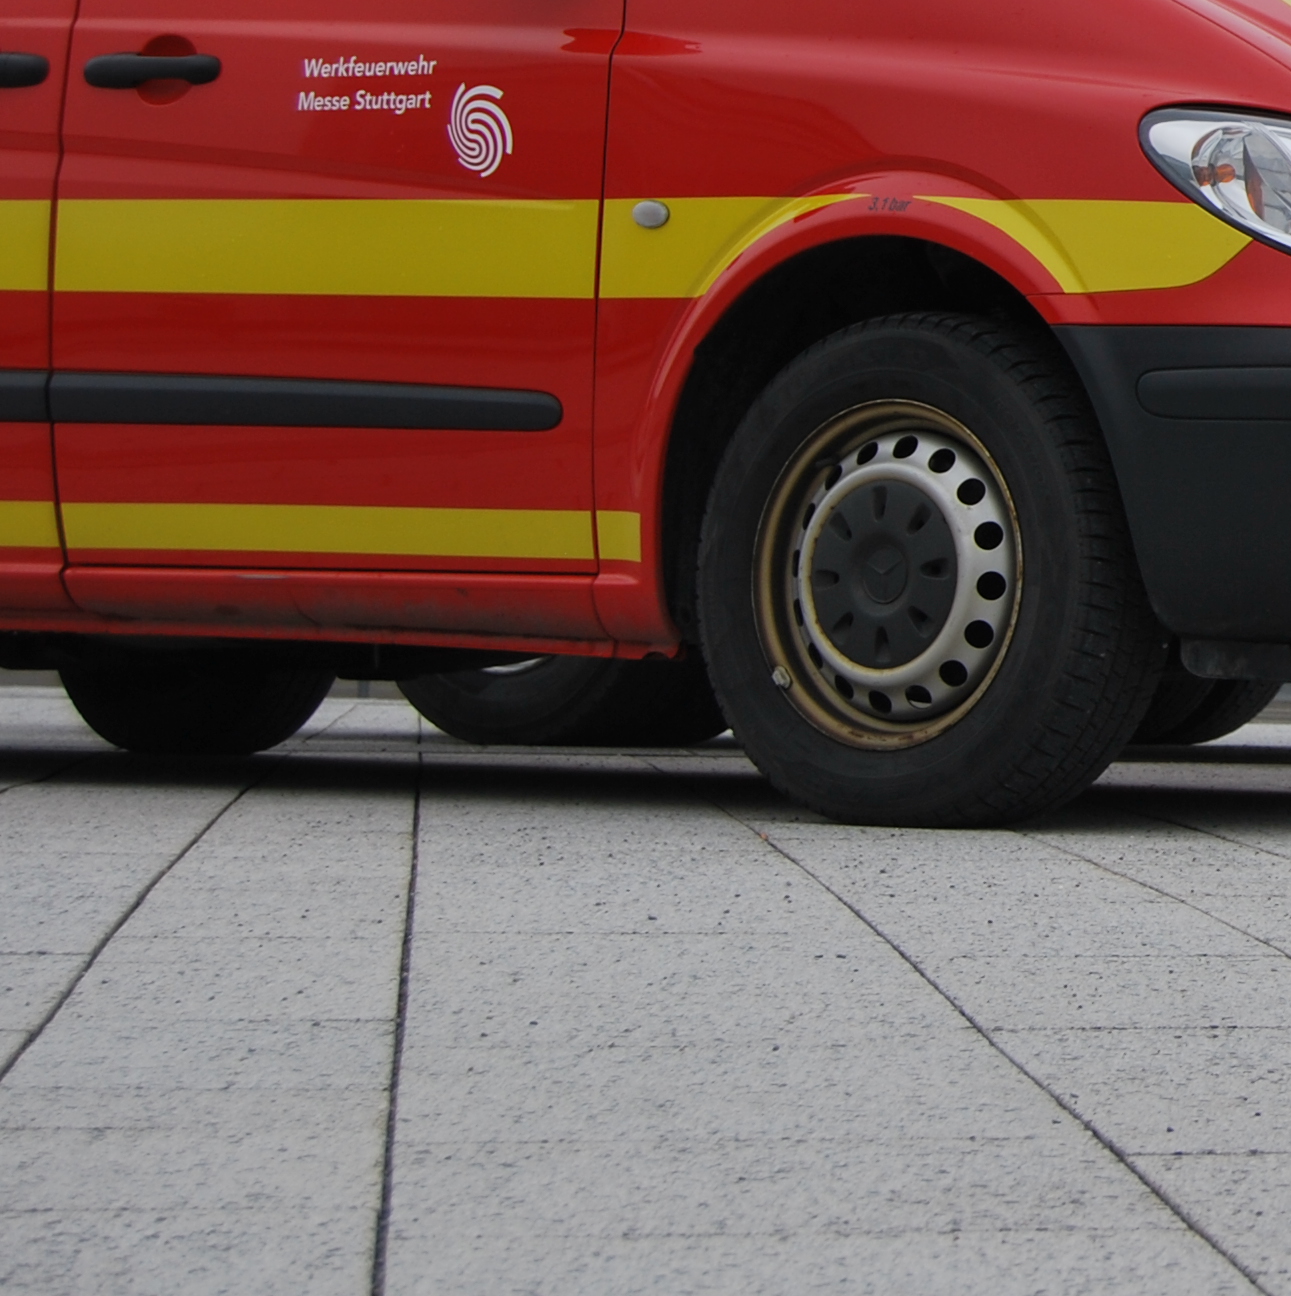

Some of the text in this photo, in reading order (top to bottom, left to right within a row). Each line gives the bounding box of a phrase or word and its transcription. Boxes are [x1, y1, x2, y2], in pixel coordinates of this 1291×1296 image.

[304, 54, 437, 78] Werkfeuerwehr
[298, 90, 432, 115] Messe Stuttgart
